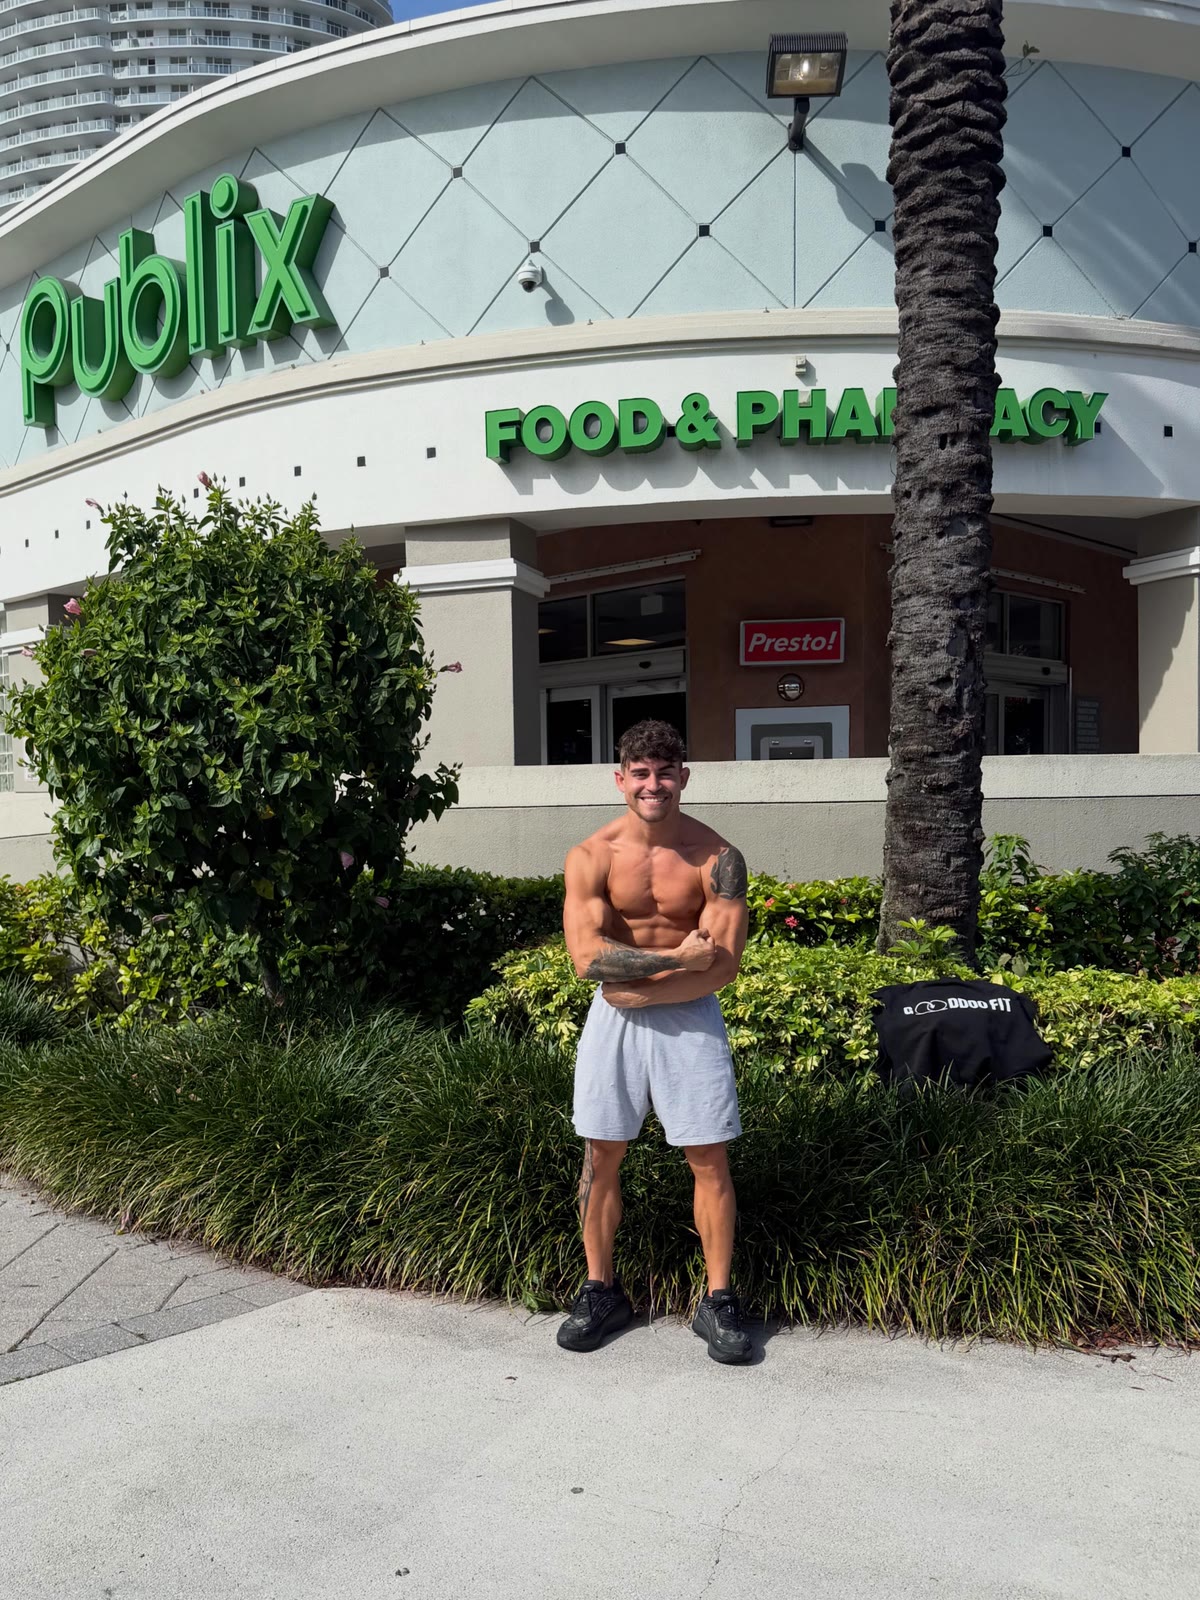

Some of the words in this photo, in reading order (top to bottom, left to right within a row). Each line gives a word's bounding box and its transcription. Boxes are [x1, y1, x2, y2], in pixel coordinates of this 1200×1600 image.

[485, 398, 665, 463] FOOD
[675, 392, 722, 450] &
[735, 387, 1109, 448] PHAACY
[748, 630, 838, 653] Presto!
[989, 997, 1012, 1013] FIT
